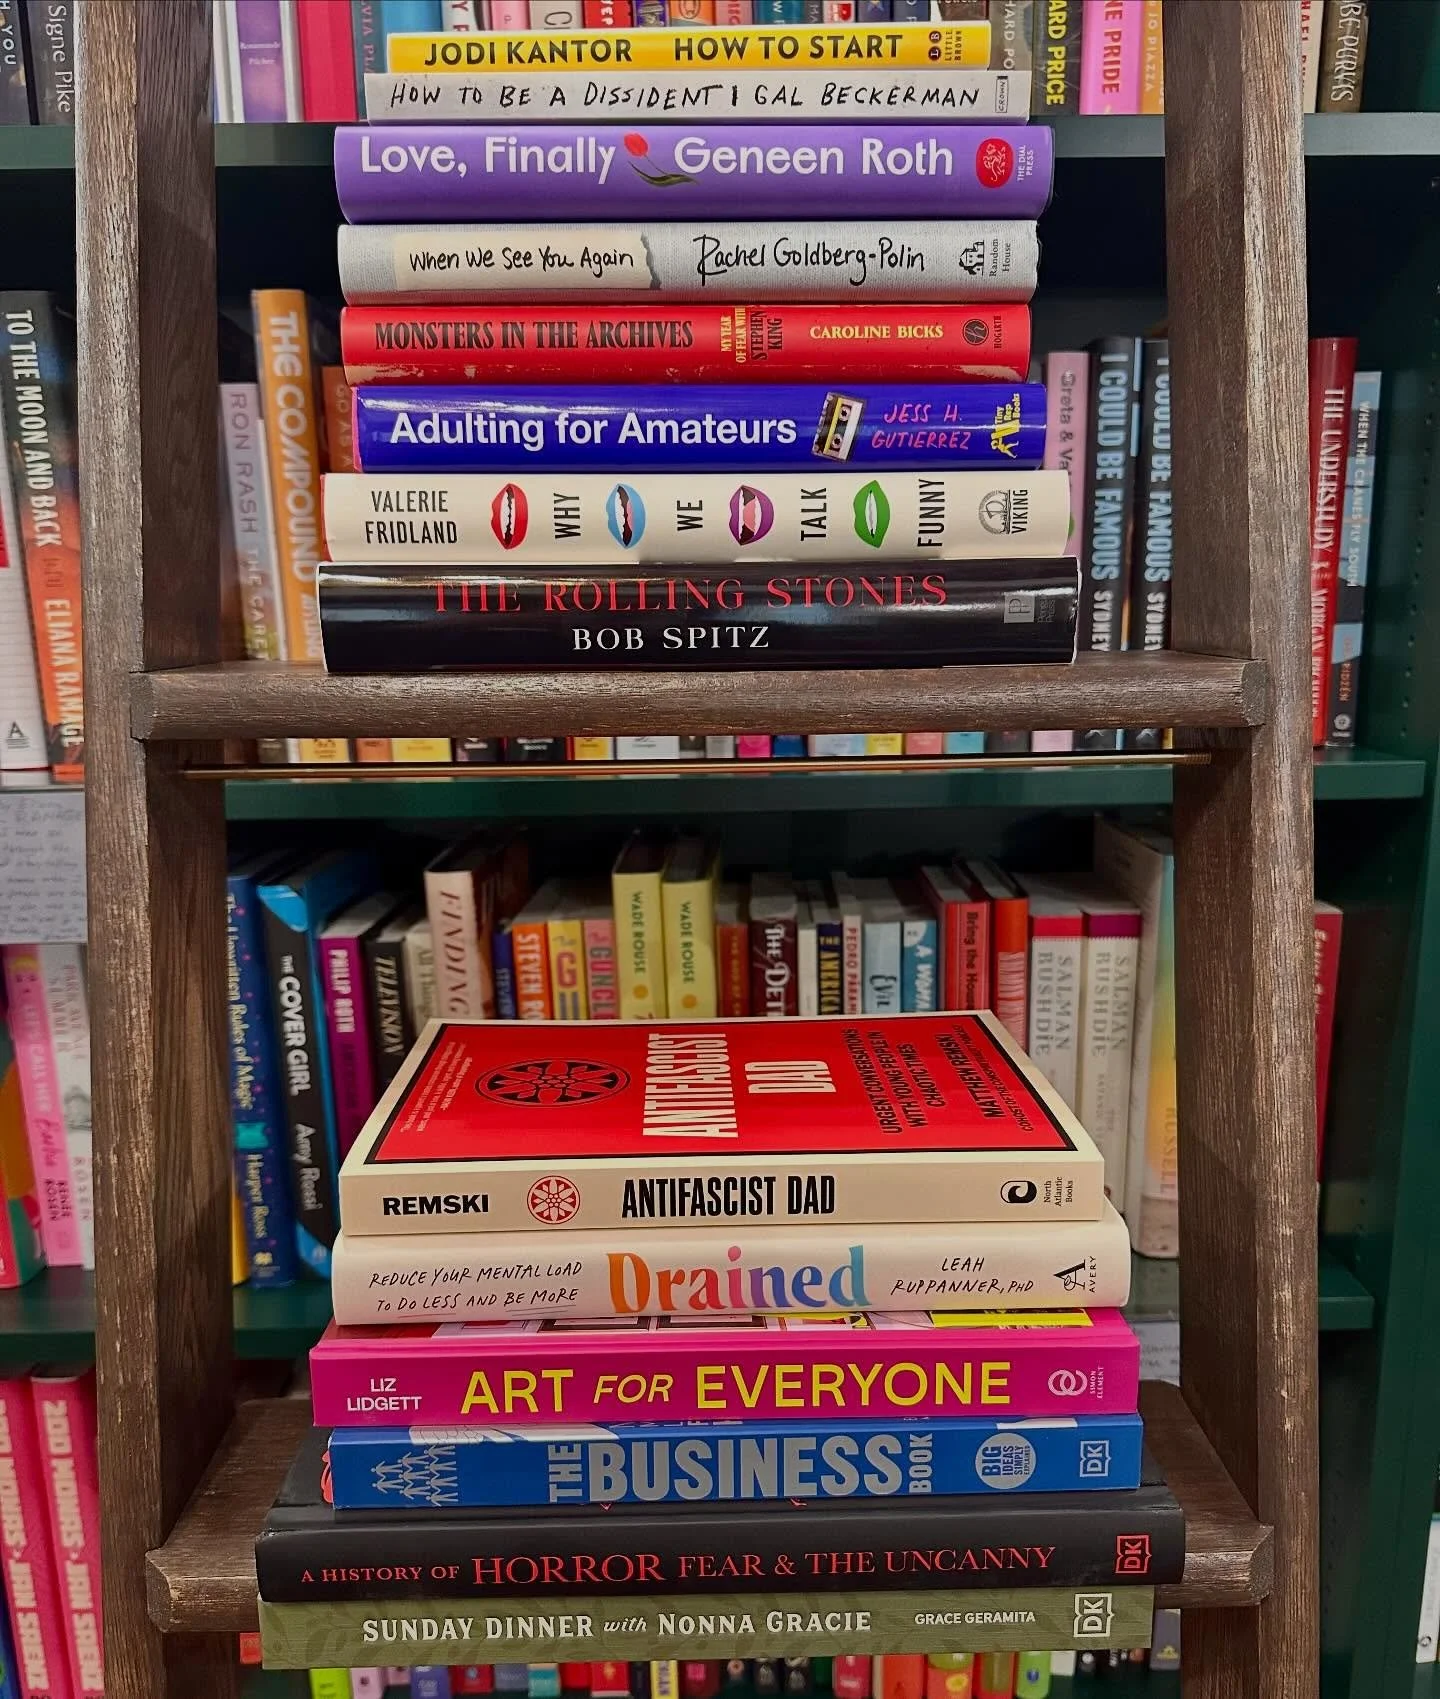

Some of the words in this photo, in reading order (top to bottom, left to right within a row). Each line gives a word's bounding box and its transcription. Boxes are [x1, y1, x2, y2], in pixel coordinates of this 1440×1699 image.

[1, 26, 17, 65] YOU
[45, 5, 67, 62] Signe
[425, 42, 495, 65] JODI
[507, 40, 632, 63] KANTOR
[674, 36, 749, 61] HOW
[758, 36, 800, 60] TO
[809, 34, 903, 59] START
[1046, 46, 1066, 105] PRICE
[1102, 30, 1120, 95] PRIDE
[1143, 35, 1158, 92] PIAZZA
[1331, 36, 1360, 102] PURVIS
[54, 71, 75, 113] Pike
[391, 83, 441, 108] HOW
[459, 86, 482, 105] TO
[500, 86, 532, 108] BE
[550, 87, 566, 106] A
[584, 82, 723, 110] DISSIDENT
[755, 85, 803, 107] GAL
[821, 83, 979, 108] BECKERMAN
[361, 136, 467, 178] Love,
[485, 136, 617, 185] Finally
[673, 136, 844, 176] Geneen
[861, 138, 953, 176] Roth
[409, 250, 460, 272] When
[466, 247, 495, 269] We
[502, 247, 534, 269] See
[538, 246, 575, 272] You
[580, 246, 634, 278] Again
[693, 234, 766, 286] Rachel
[773, 236, 925, 286] Goldberg-Polin
[989, 238, 999, 277] Random
[1002, 242, 1011, 273] House
[5, 310, 35, 336] TO
[375, 321, 495, 350] MONSTERS
[500, 321, 526, 349] IN
[532, 321, 578, 349] THE
[586, 320, 693, 349] ARCHIVES
[721, 315, 732, 337] YEAR
[736, 327, 747, 347] FEAR
[752, 310, 768, 361] STEPHEN
[768, 318, 783, 351] KING
[810, 325, 891, 340] CAROLINE
[897, 324, 944, 339] BICKS
[994, 315, 1002, 349] HOGARTH
[10, 341, 41, 380] THE
[269, 312, 303, 377] THE
[16, 385, 49, 444] MOON
[230, 393, 251, 450] RON
[884, 404, 929, 423] JESS
[943, 404, 961, 422] H.
[1098, 370, 1128, 446] COULD
[1323, 386, 1345, 420] THE
[390, 412, 544, 451] Adulting
[555, 412, 608, 444] for
[617, 412, 797, 444] Amateurs
[871, 430, 971, 450] GUTIERREZ
[24, 450, 54, 490] AND
[276, 384, 320, 582] COMPOUND
[1096, 451, 1125, 480] BE
[237, 462, 257, 533] RASH
[371, 490, 448, 512] VALERIE
[1313, 429, 1343, 552] UNDERSTUDY
[30, 495, 62, 547] BACK
[553, 492, 581, 539] WHY
[677, 500, 703, 531] WE
[801, 487, 827, 541] TALK
[917, 478, 945, 547] FUNNY
[1011, 489, 1028, 534] VIKING
[365, 520, 458, 544] FRIDLAND
[1091, 488, 1124, 580] FAMOUS
[435, 580, 521, 612] THE
[544, 577, 743, 612] ROLLING
[766, 575, 947, 609] STONES
[43, 599, 80, 666] ELIANA
[572, 627, 645, 651] BOB
[663, 626, 769, 650] SPITZ
[632, 892, 644, 928] WADE
[680, 902, 692, 937] WADE
[964, 912, 978, 945] Bring
[518, 933, 543, 994] STEVEN
[634, 931, 645, 974] ROUSE
[682, 943, 694, 984] ROUSE
[278, 975, 307, 1046] COVER
[375, 957, 404, 1053] TELEVISION
[1055, 955, 1072, 1050] SALMAN
[1111, 955, 1129, 1050] SALMAN
[842, 1028, 883, 1094] CONVERSATIONS
[897, 1043, 925, 1068] TIMES
[936, 1033, 969, 1067] REMSKI
[286, 1050, 312, 1096] GIRL
[643, 1033, 738, 1138] ANTIFASCIST
[745, 1060, 836, 1093] DAD
[889, 1069, 913, 1100] YOUNG
[913, 1068, 945, 1107] CHAOTIC
[957, 1066, 1006, 1119] MATTHEW
[870, 1091, 902, 1134] URGENT
[900, 1101, 928, 1127] WITH
[383, 1195, 489, 1216] REMSKI
[622, 1176, 776, 1218] ANTIFASCIST
[787, 1175, 835, 1215] DAD
[1043, 1180, 1052, 1203] North
[1055, 1176, 1063, 1207] Atlantic
[1065, 1180, 1074, 1203] Books
[369, 1271, 427, 1288] REDUCE
[430, 1267, 471, 1286] YOUR
[477, 1264, 541, 1283] MENTAL
[547, 1261, 582, 1277] LOAD
[606, 1245, 872, 1314] Drained
[941, 1257, 985, 1273] LEAH
[1089, 1256, 1097, 1293] AVERY
[422, 1293, 457, 1310] LESS
[466, 1293, 497, 1308] AND
[504, 1291, 525, 1307] BE
[530, 1287, 579, 1305] MORE
[891, 1278, 1005, 1296] RUPPANNER,
[347, 1396, 422, 1412] LIDGETT
[370, 1378, 397, 1393] LIZ
[460, 1369, 574, 1415] ART
[593, 1374, 674, 1404] FOR
[697, 1361, 1011, 1409] EVERYONE
[548, 1442, 582, 1503] THE
[588, 1434, 902, 1502] BUSINESS
[909, 1433, 934, 1494] BOOK
[982, 1446, 1002, 1477] BIG
[1002, 1445, 1014, 1477] IDEAS
[1014, 1445, 1024, 1478] SIMPLY
[301, 1570, 315, 1583] A
[320, 1566, 423, 1582] HISTORY
[431, 1566, 461, 1580] OF
[472, 1555, 666, 1585] HORROR
[678, 1554, 766, 1577] FEAR
[774, 1555, 796, 1575] &
[805, 1551, 876, 1575] THE
[883, 1546, 1056, 1573] UNCANNY
[363, 1617, 474, 1642] SUNDAY
[486, 1615, 594, 1640] DINNER
[603, 1616, 648, 1634] with
[658, 1613, 755, 1635] NONNA
[766, 1610, 872, 1633] GRACIE
[915, 1612, 961, 1625] GRACE
[965, 1611, 1035, 1624] GERAMITA
[1081, 1597, 1105, 1632] DK
